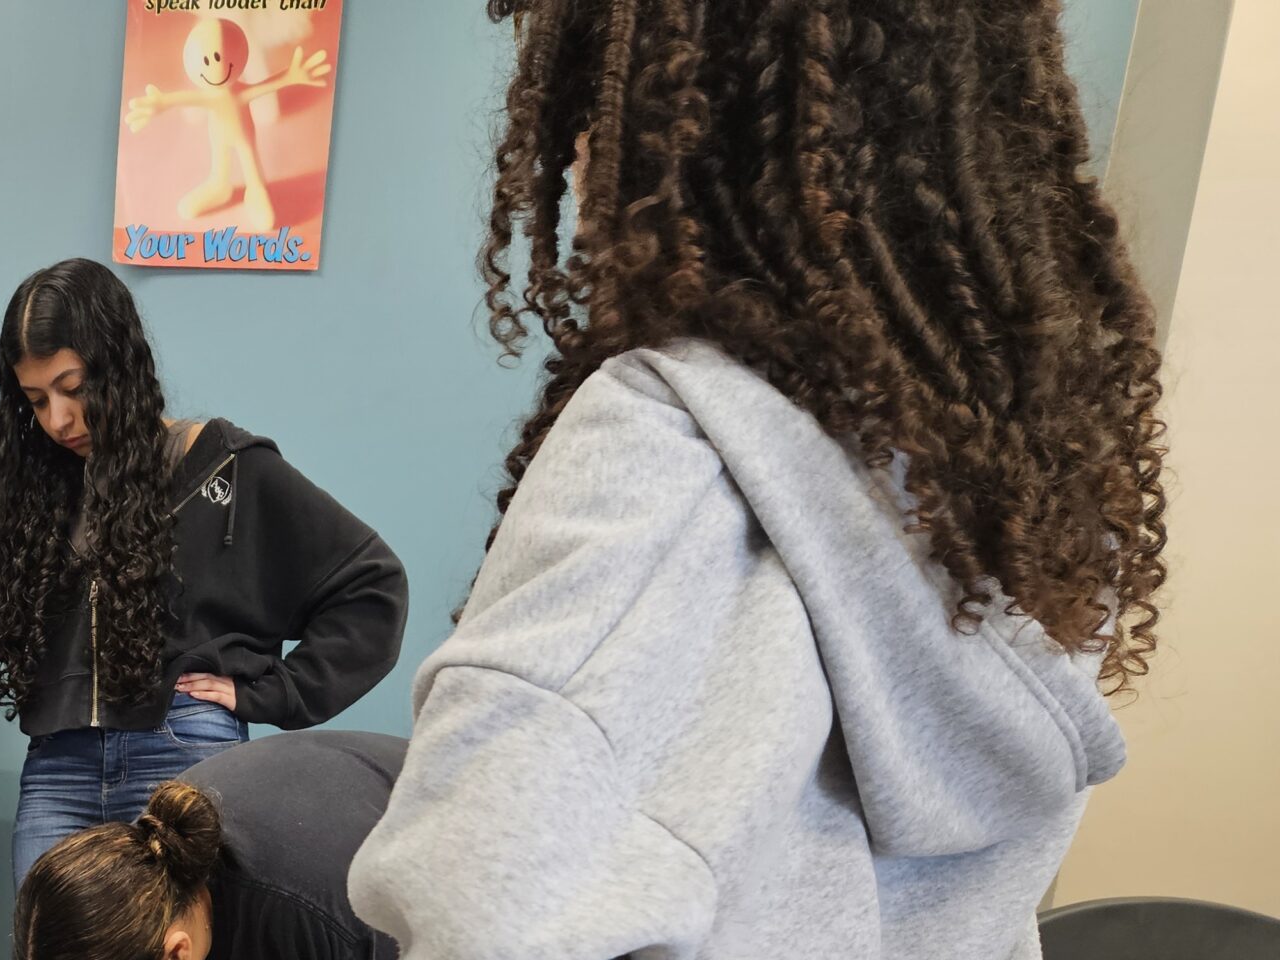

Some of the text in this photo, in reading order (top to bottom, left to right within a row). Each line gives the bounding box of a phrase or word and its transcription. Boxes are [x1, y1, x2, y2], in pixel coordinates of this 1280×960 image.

[145, 0, 326, 13] speak louder than
[124, 223, 312, 263] Your Words.
